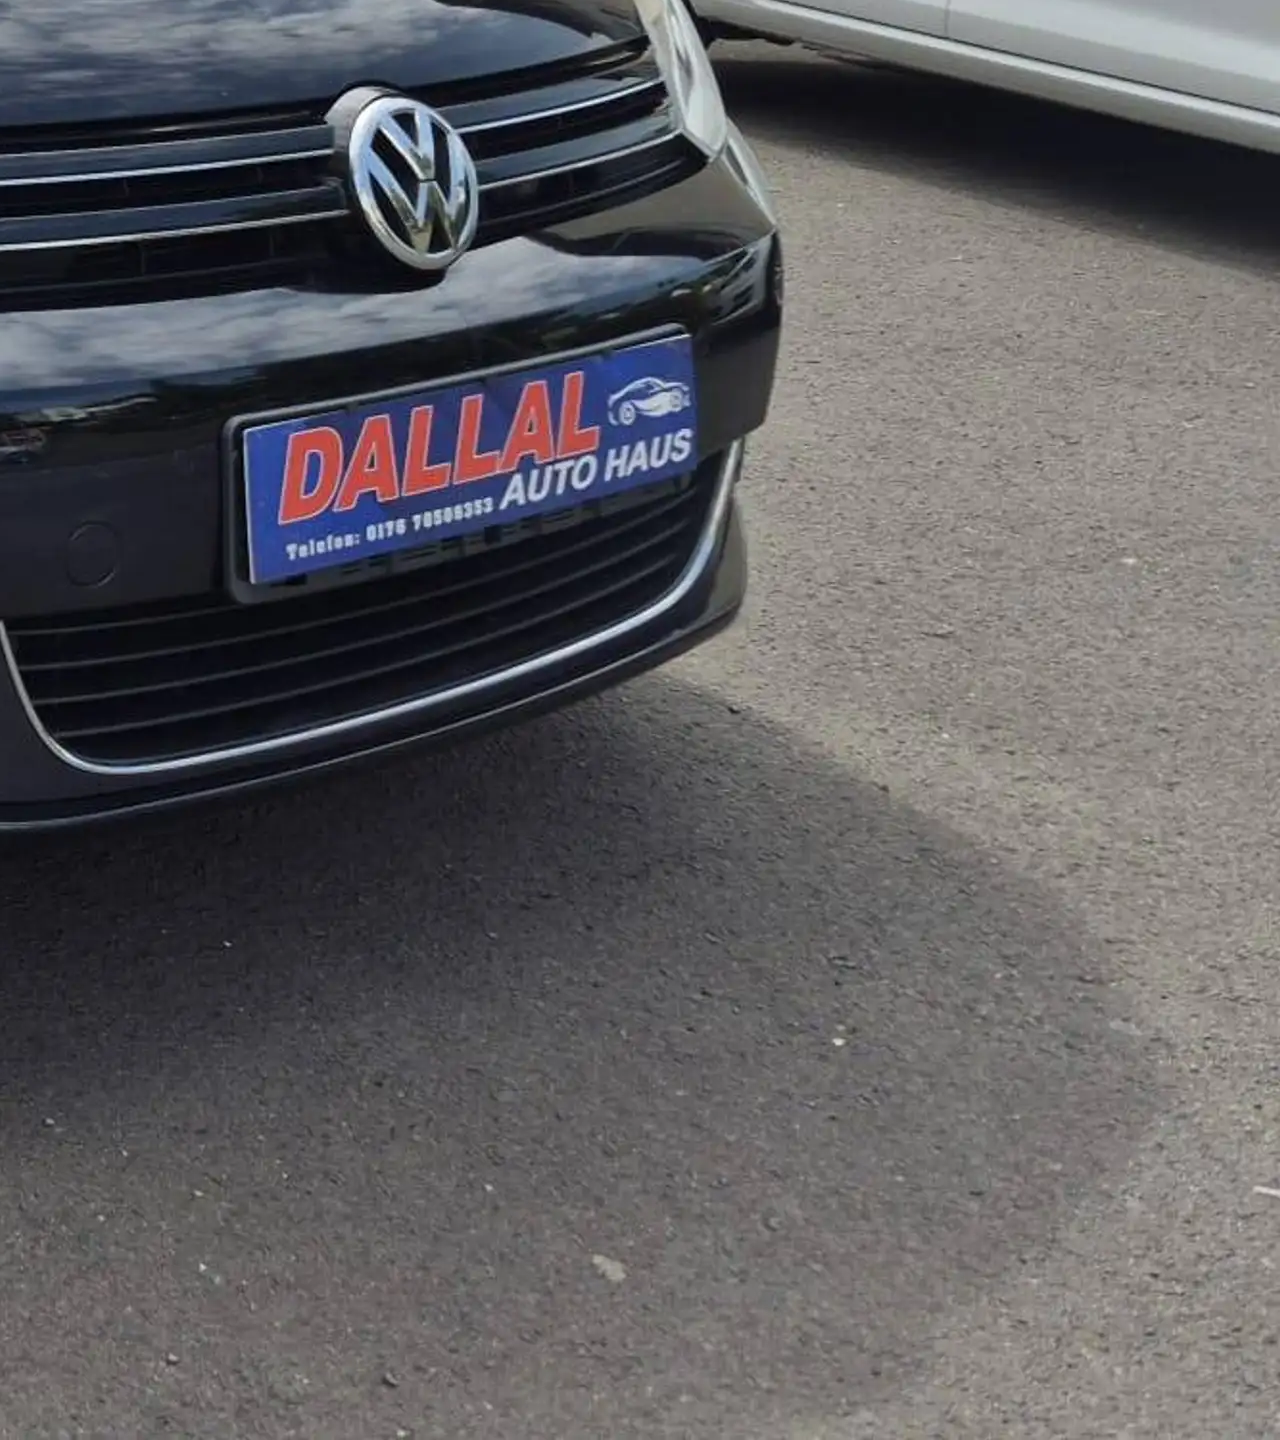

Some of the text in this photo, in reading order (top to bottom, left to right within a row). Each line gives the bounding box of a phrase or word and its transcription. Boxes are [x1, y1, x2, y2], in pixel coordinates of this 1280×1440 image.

[278, 371, 600, 525] DALLAL
[499, 428, 695, 510] AUTO HAUS
